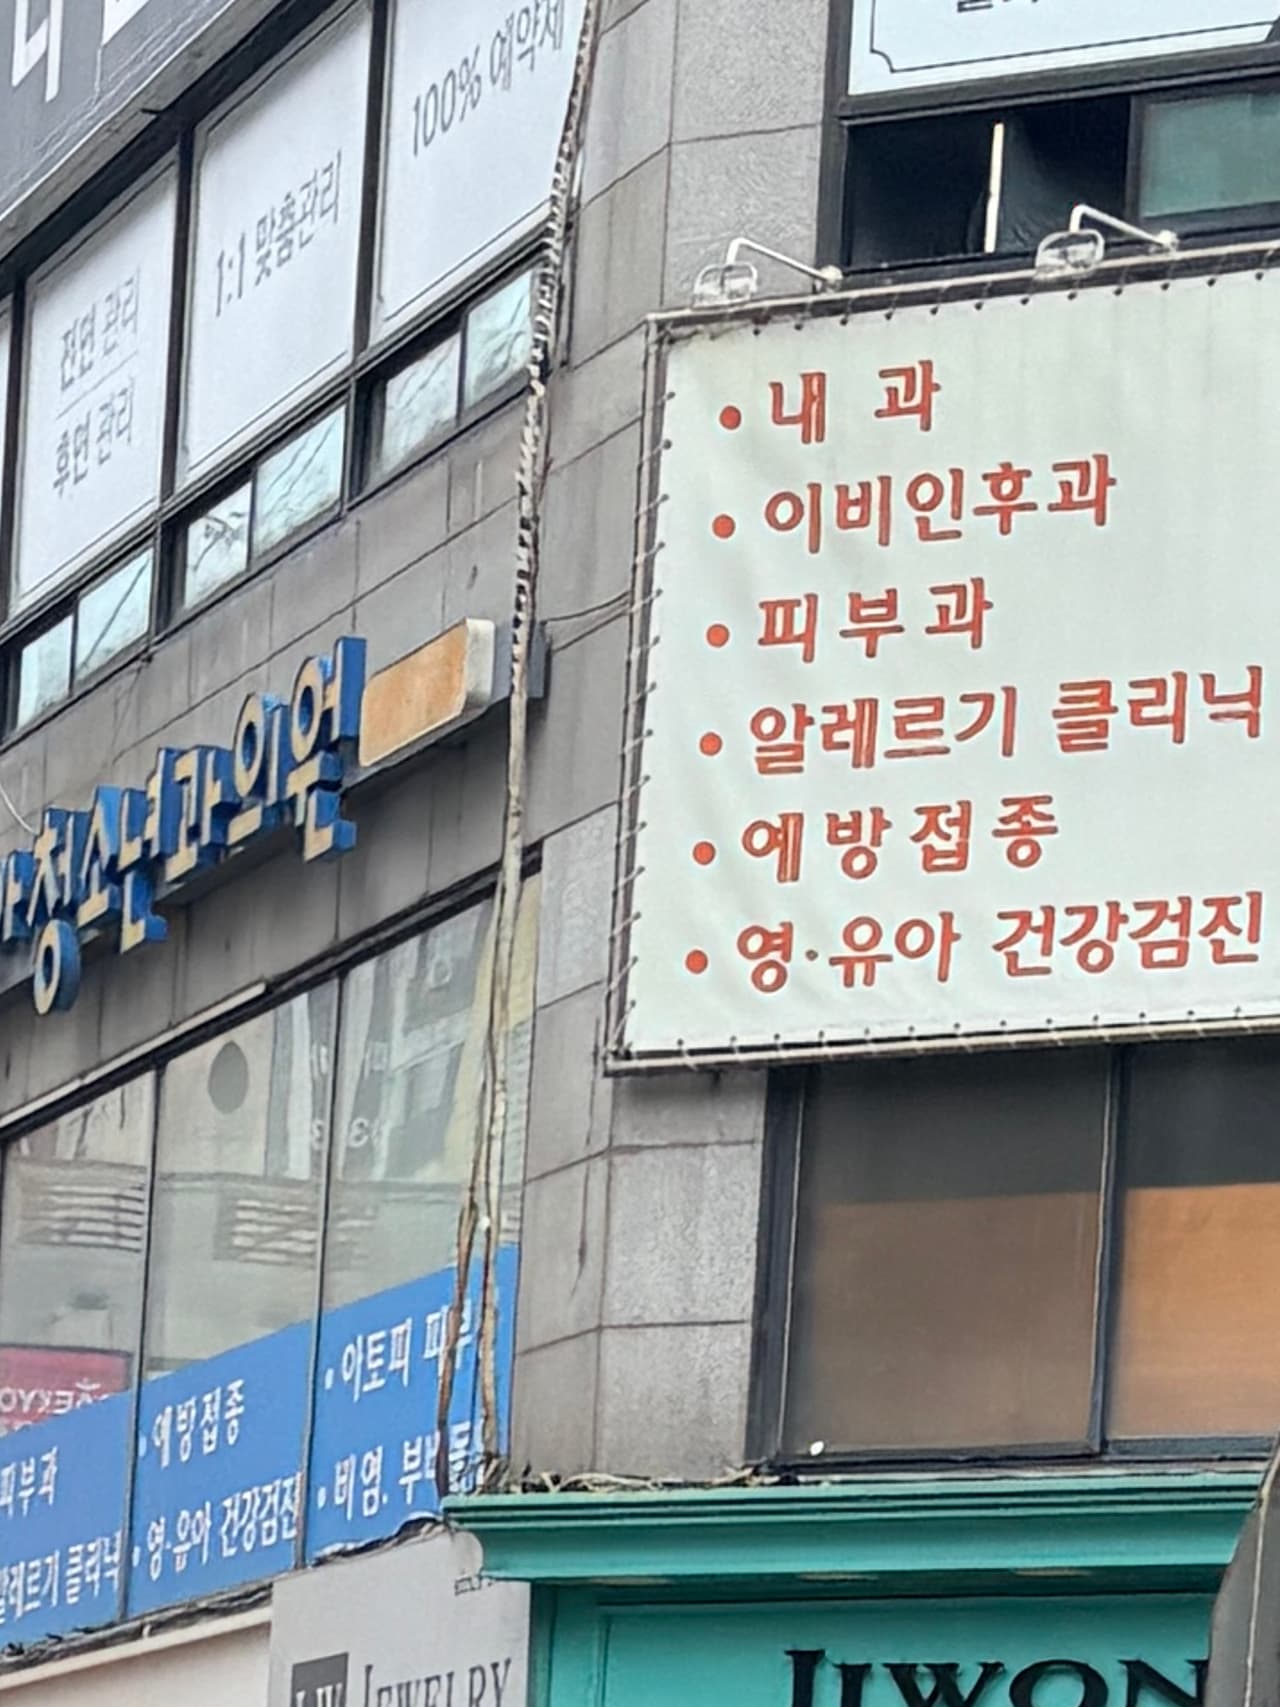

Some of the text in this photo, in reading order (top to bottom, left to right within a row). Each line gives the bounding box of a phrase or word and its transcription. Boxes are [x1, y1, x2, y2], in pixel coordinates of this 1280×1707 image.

[413, 45, 482, 158] 100%
[215, 232, 246, 317] 1:1
[765, 453, 1118, 554] 이비인후과
[757, 576, 995, 663] 피부과
[749, 665, 1265, 775] 알레르기 클리닉
[741, 794, 1059, 884] 예방접종
[737, 891, 1265, 994] 영·유아 건강검진
[342, 1315, 414, 1404] 아토피
[152, 1378, 246, 1471] 예방접종
[220, 1470, 306, 1558] 건강검진
[66, 1529, 123, 1607] 클리닉
